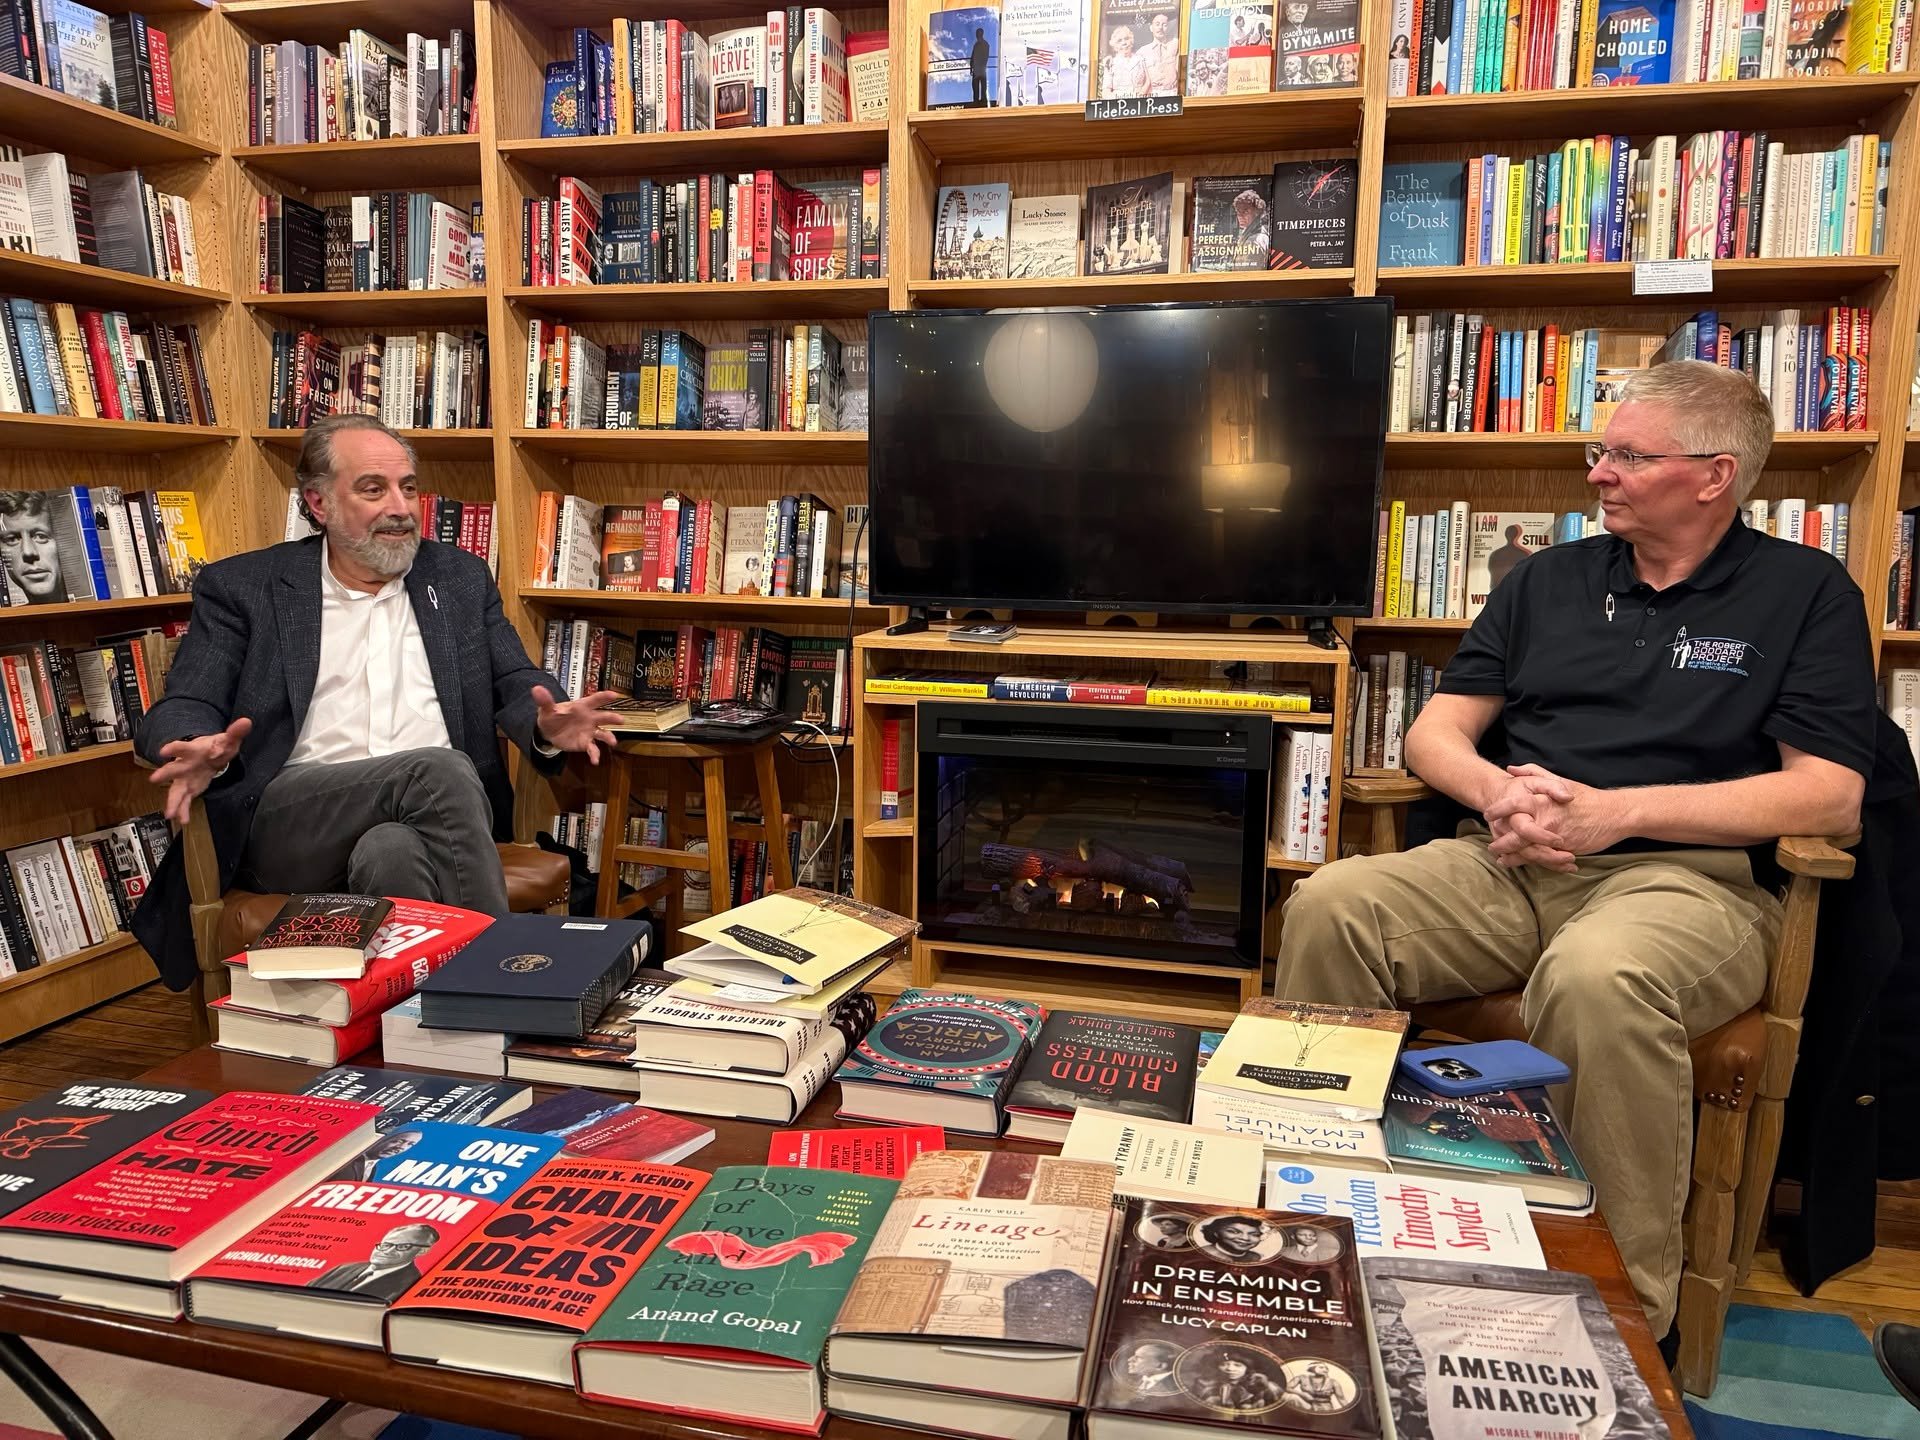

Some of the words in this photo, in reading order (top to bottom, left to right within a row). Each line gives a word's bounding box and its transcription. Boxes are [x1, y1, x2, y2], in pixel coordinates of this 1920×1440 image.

[1006, 12, 1015, 21] It's
[1016, 11, 1037, 20] Where
[1038, 10, 1051, 18] You
[1052, 9, 1072, 17] Finish
[70, 24, 92, 37] FATE
[95, 34, 106, 42] OF
[1609, 18, 1652, 34] HOME
[59, 31, 76, 43] THE
[80, 38, 99, 50] DAY
[1283, 28, 1355, 50] DYNAMITE
[1596, 40, 1667, 57] CHOOLED
[1091, 101, 1141, 118] TidePool
[1147, 103, 1179, 115] Press
[1620, 141, 1628, 149] A
[1395, 173, 1429, 191] The
[1825, 156, 1834, 191] MOSTLY
[610, 201, 639, 212] AMER
[1110, 204, 1138, 217] Proper
[1140, 201, 1153, 211] Fit
[1385, 190, 1443, 207] Beauty
[1823, 193, 1832, 221] SUNNY
[561, 202, 571, 232] ALLIES
[795, 203, 848, 229] FAMILY
[1022, 210, 1043, 220] Lucky
[1044, 209, 1066, 217] Stones
[1389, 205, 1410, 223] of
[1406, 213, 1450, 230] Dusk
[1615, 199, 1624, 223] Paris
[1199, 224, 1215, 234] THE
[1277, 219, 1346, 231] TIMEPIECES
[448, 227, 468, 245] GOOD
[562, 237, 570, 248] AT
[795, 232, 813, 255] OF
[1199, 235, 1233, 245] PERFECT
[448, 252, 465, 267] MAD
[1198, 245, 1261, 257] ASSIGNMENT
[1389, 242, 1439, 261] Frank
[561, 253, 570, 274] WAR
[793, 258, 836, 281] SPIES
[119, 324, 135, 368] BIRCHERS
[22, 323, 44, 391] RECKONING
[1469, 352, 1476, 366] NO
[1784, 361, 1796, 372] 10
[1463, 368, 1475, 420] SURRENDER
[622, 509, 644, 521] DARK
[797, 503, 806, 535] REBEL
[1790, 509, 1800, 539] CHASING
[605, 521, 644, 534] RENAISSA
[1821, 522, 1830, 548] class
[1522, 534, 1551, 546] STILL
[684, 547, 693, 585] REVOLUTION
[642, 643, 676, 660] KING
[1693, 647, 1744, 657] GODDARD
[1714, 642, 1747, 650] ROBERT
[1691, 654, 1743, 665] PROJECT
[871, 682, 892, 690] Radical
[893, 684, 929, 692] Cartography
[939, 686, 961, 694] William
[963, 687, 984, 695] Rankin
[1010, 690, 1051, 699] REVOLUTION
[1021, 683, 1055, 692] AMERICAN
[1159, 695, 1168, 704] A
[1171, 695, 1231, 708] SHIMMER
[1236, 697, 1252, 708] OF
[1257, 699, 1277, 710] JOY
[23, 868, 39, 908] Challenger
[43, 862, 59, 901] Challenger
[904, 996, 966, 1004] BADAWI
[974, 999, 1026, 1018] ZEINAB
[649, 1006, 711, 1021] STRUGGLE
[716, 1014, 786, 1028] AMERICAN
[1068, 1018, 1112, 1029] PUHAK
[896, 1021, 1003, 1042] AFRICA
[1117, 1024, 1175, 1038] SHELLEY
[903, 1041, 969, 1053] AFRICAN
[923, 1036, 988, 1049] HISTORY
[1046, 1043, 1178, 1073] COUNTESS
[1050, 1060, 1162, 1092] BLOOD
[1391, 1092, 1479, 1115] Museum
[211, 1104, 345, 1126] SEPARATION
[1456, 1113, 1491, 1126] The
[1489, 1107, 1551, 1122] Great
[1215, 1114, 1365, 1138] EMANUEL
[162, 1119, 320, 1158] Church
[1225, 1125, 1357, 1150] MOTHER
[458, 1139, 541, 1169] ONE
[789, 1153, 798, 1162] ON
[875, 1141, 884, 1170] PROTECT
[886, 1137, 895, 1175] DEMOCRACY
[117, 1152, 274, 1181] HATE
[381, 1159, 507, 1195] MAN'S
[543, 1167, 605, 1182] IBRAM
[607, 1171, 626, 1182] X.
[630, 1175, 694, 1190] KENDI
[730, 1177, 815, 1198] Days
[293, 1183, 479, 1225] FREEDOM
[511, 1185, 678, 1224] CHAIN
[712, 1200, 755, 1214] of
[1286, 1192, 1327, 1215] On
[1335, 1178, 1383, 1247] Freedom
[22, 1210, 76, 1224] JOHN
[70, 1214, 177, 1239] FUGELSANG
[912, 1214, 1060, 1241] Lineage
[1385, 1183, 1440, 1251] Timothy
[1438, 1197, 1500, 1251] Snyder
[482, 1214, 573, 1242] OF
[700, 1220, 784, 1241] Love
[950, 1238, 1013, 1246] GENEALOGY
[221, 1250, 276, 1266] NICHOLAS
[277, 1257, 326, 1269] BUCCOLA
[442, 1242, 626, 1287] IDEAS
[652, 1272, 754, 1298] Rage
[1154, 1264, 1322, 1293] DREAMING
[429, 1276, 460, 1287] THE
[462, 1278, 532, 1296] ORIGINS
[536, 1287, 559, 1296] OF
[563, 1289, 597, 1304] OUR
[1132, 1281, 1163, 1295] IN
[1173, 1286, 1344, 1315] ENSEMBLE
[415, 1287, 549, 1311] AUTHORITARIAN
[551, 1303, 589, 1317] AGE
[627, 1306, 719, 1324] Anand
[722, 1312, 802, 1336] Gopal
[1122, 1298, 1144, 1306] How
[1146, 1300, 1173, 1308] Black
[1175, 1303, 1206, 1313] Artists
[1209, 1308, 1270, 1320] Transformed
[1272, 1314, 1320, 1324] American
[1322, 1319, 1353, 1328] Opera
[1161, 1313, 1215, 1329] LUCY
[1221, 1321, 1307, 1339] CAPLAN
[1438, 1354, 1600, 1390] AMERICAN
[1452, 1385, 1600, 1418] ANARCHY
